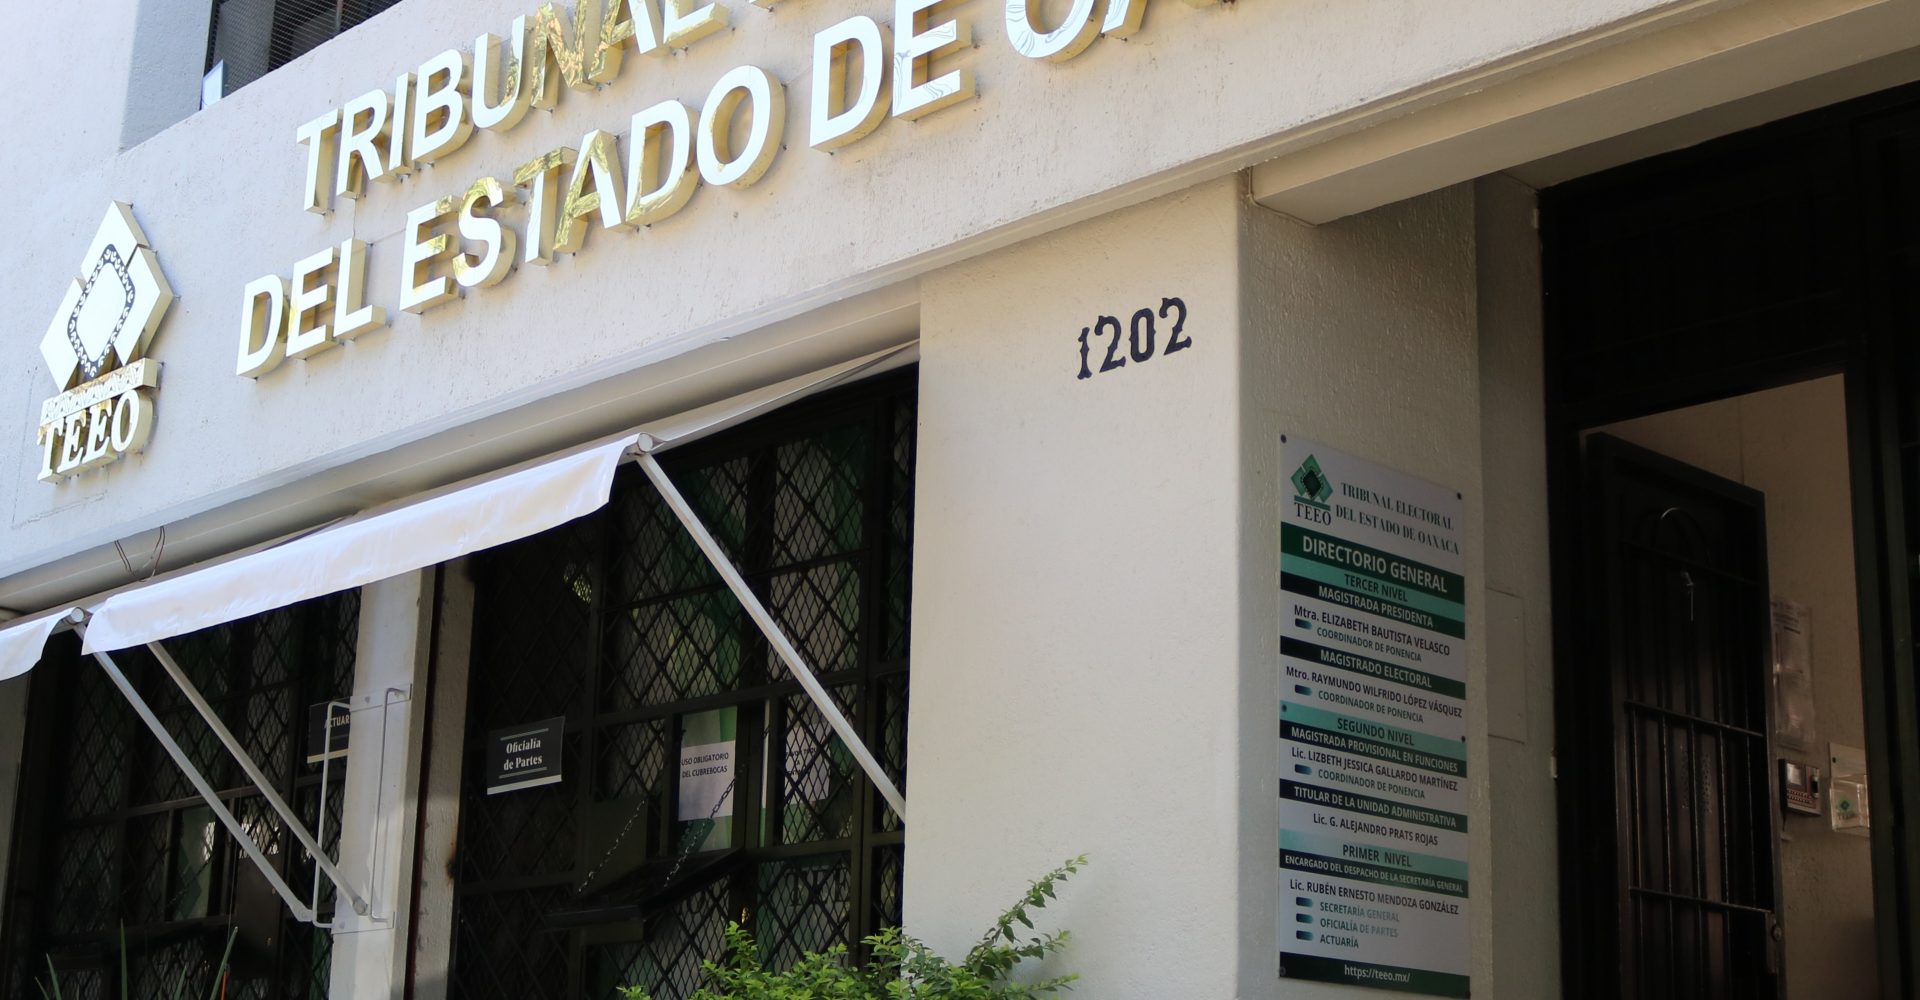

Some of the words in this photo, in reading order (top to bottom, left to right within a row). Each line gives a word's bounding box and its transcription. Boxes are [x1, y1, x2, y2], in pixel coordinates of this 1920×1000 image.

[236, 238, 376, 377] DEL
[400, 65, 771, 313] ESTADO
[809, 0, 962, 149] DE
[1077, 297, 1192, 380] 1202
[37, 389, 142, 481] TEEO
[1294, 502, 1332, 526] TEEO
[1341, 482, 1394, 511] TRIBUNAL
[1396, 500, 1454, 531] ELECTORAL
[1336, 504, 1357, 522] DEL
[1359, 510, 1400, 536] ESTADO
[1403, 523, 1416, 541] DE
[1418, 528, 1459, 556] OAXACA
[1303, 535, 1386, 574] DIRECTORIO
[1390, 561, 1448, 593] GENERAL
[1344, 573, 1379, 594] TERCER
[1382, 585, 1408, 603] NIVEL
[1319, 585, 1379, 613] MAGISTRADA
[1381, 603, 1433, 628] PRESIDENTA
[1294, 604, 1319, 621] Mtra.
[1322, 612, 1369, 634] ELIZABETH
[1372, 625, 1413, 646] BAUTISTA
[1414, 636, 1450, 656] VELASCO
[1317, 626, 1373, 649] COORDINADOR
[1375, 641, 1384, 652] DE
[1386, 644, 1422, 662] PONENCIA
[1320, 650, 1382, 675] MAGISTRADO
[1384, 665, 1432, 688] ELECTORAL
[1286, 665, 1310, 681] Mtro.
[1311, 673, 1361, 693] RAYMUNDO
[1363, 684, 1401, 703] WILFRIDO
[1403, 691, 1427, 709] LÓPEZ
[1428, 699, 1462, 719] VÁSQUEZ
[1318, 690, 1375, 712] COORDINADOR
[1376, 704, 1386, 714] DE
[1387, 706, 1423, 723] PONENCIA
[1291, 726, 1346, 749] MAGISTRADA
[1348, 736, 1401, 761] PROVISIONAL
[1403, 750, 1413, 763] EN
[1415, 752, 1458, 773] FUNCIONES
[1337, 718, 1385, 739] SEGUNDO
[1387, 728, 1414, 746] NIVEL
[503, 759, 514, 771] de
[515, 755, 543, 769] Partes
[681, 757, 692, 766] USO
[694, 752, 729, 764] OBLIGATORIO
[682, 770, 691, 778] DEL
[692, 765, 728, 777] CUBREBOCAS
[1292, 747, 1306, 760] Lic.
[1308, 751, 1342, 768] LIZBETH
[1344, 757, 1373, 775] JESSICA
[1375, 764, 1417, 783] GALLARDO
[1419, 774, 1458, 792] MARTÍNEZ
[1318, 769, 1375, 789] COORDINADOR
[1377, 782, 1386, 792] DE
[1388, 783, 1425, 799] PONENCIA
[1294, 786, 1330, 804] TITULAR
[1332, 793, 1343, 806] DE
[1344, 795, 1355, 808] LA
[1357, 798, 1389, 816] UNIDAD
[1391, 805, 1456, 828] ADMINISTRATIVA
[1313, 813, 1327, 826] Lic.
[1329, 816, 1338, 828] G.
[1340, 817, 1387, 836] ALEJANDRO
[1389, 825, 1413, 842] PRATS
[1415, 831, 1438, 847] ROJAS
[1343, 843, 1380, 863] PRIMER
[1384, 851, 1412, 868] NIVEL
[1285, 855, 1329, 872] ENCARGADO
[1330, 863, 1343, 874] DEL
[1344, 865, 1379, 880] DESPACHO
[1380, 871, 1389, 881] DE
[1390, 872, 1399, 882] LA
[1399, 873, 1436, 889] SECRETARÍA
[1437, 879, 1464, 894] GENERAL
[1290, 879, 1304, 891] Lic.
[1307, 880, 1336, 896] RUBÉN
[1339, 886, 1375, 902] ERNESTO
[1377, 892, 1417, 908] MENDOZA
[1419, 898, 1459, 915] GONZÁLEZ
[1320, 901, 1365, 917] SECRETARÍA
[1366, 909, 1399, 922] GENERAL
[1320, 918, 1358, 932] OFICIALÍA
[1360, 924, 1369, 934] DE
[1371, 925, 1398, 938] PARTES
[1320, 934, 1359, 949] ACTUARÍA
[1344, 964, 1411, 983] https://teeo.mx/
